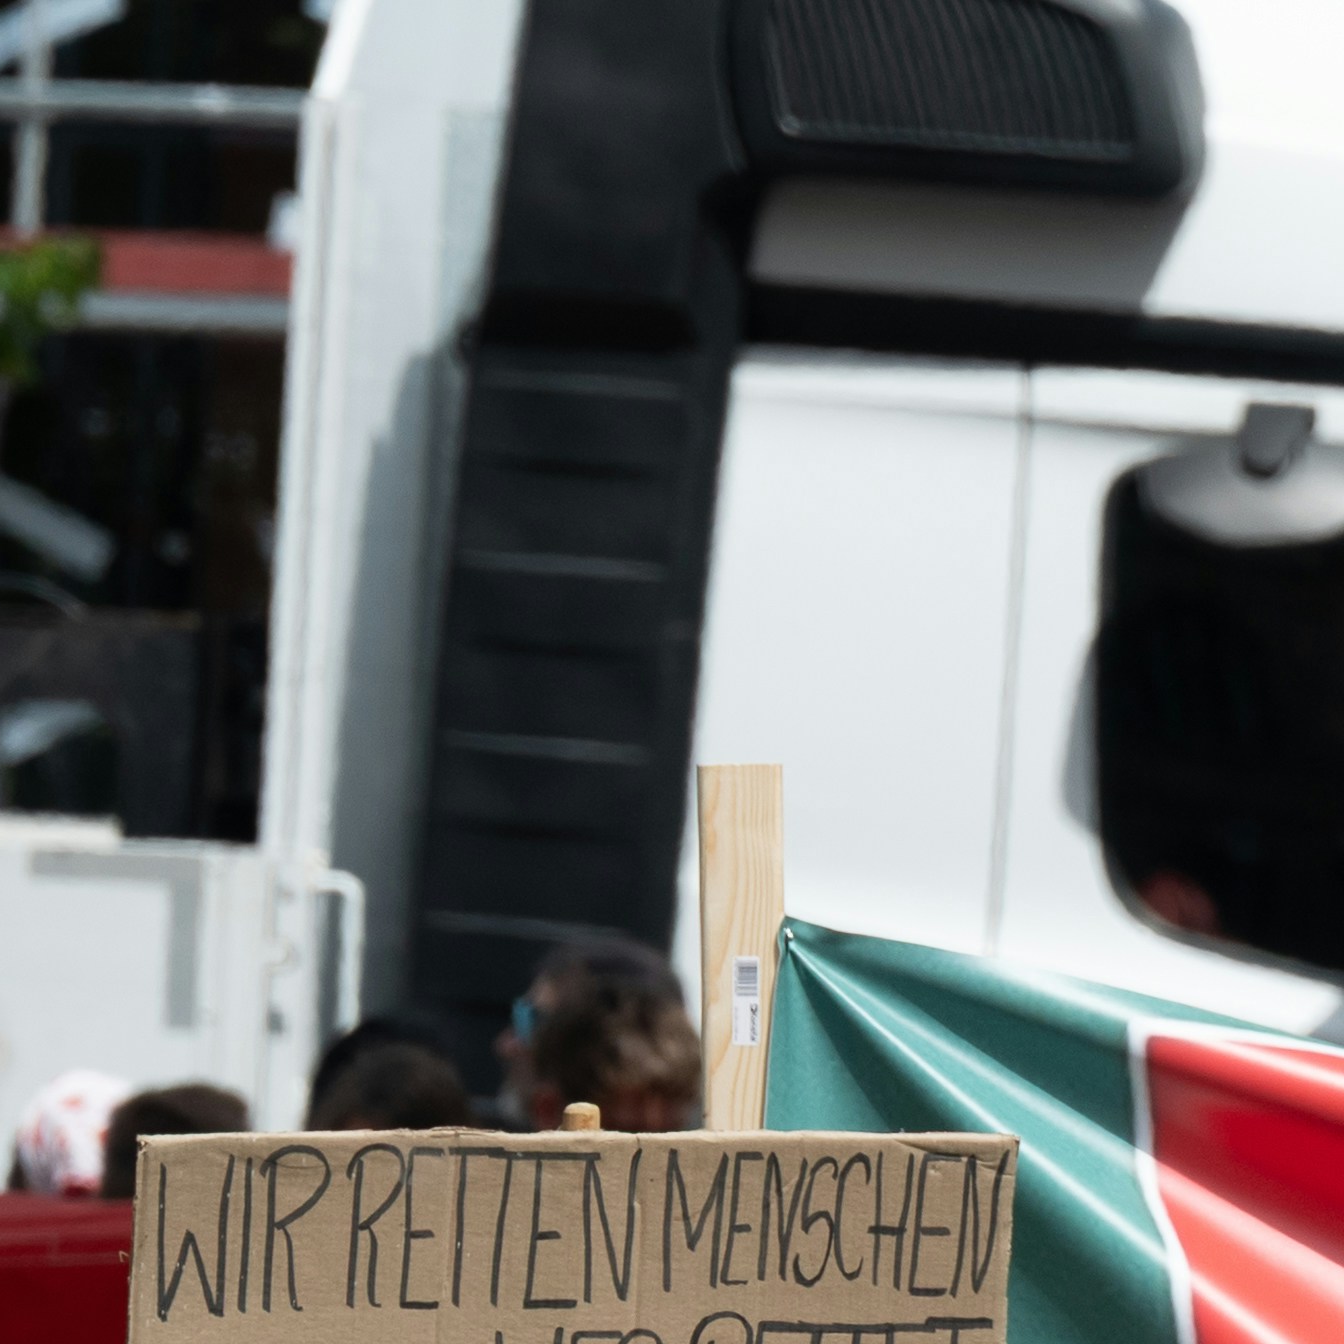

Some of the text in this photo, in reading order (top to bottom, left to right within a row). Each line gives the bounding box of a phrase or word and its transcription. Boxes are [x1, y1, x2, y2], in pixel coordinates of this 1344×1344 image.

[159, 1144, 1004, 1321] WIR RETTEN MENSCHEN
